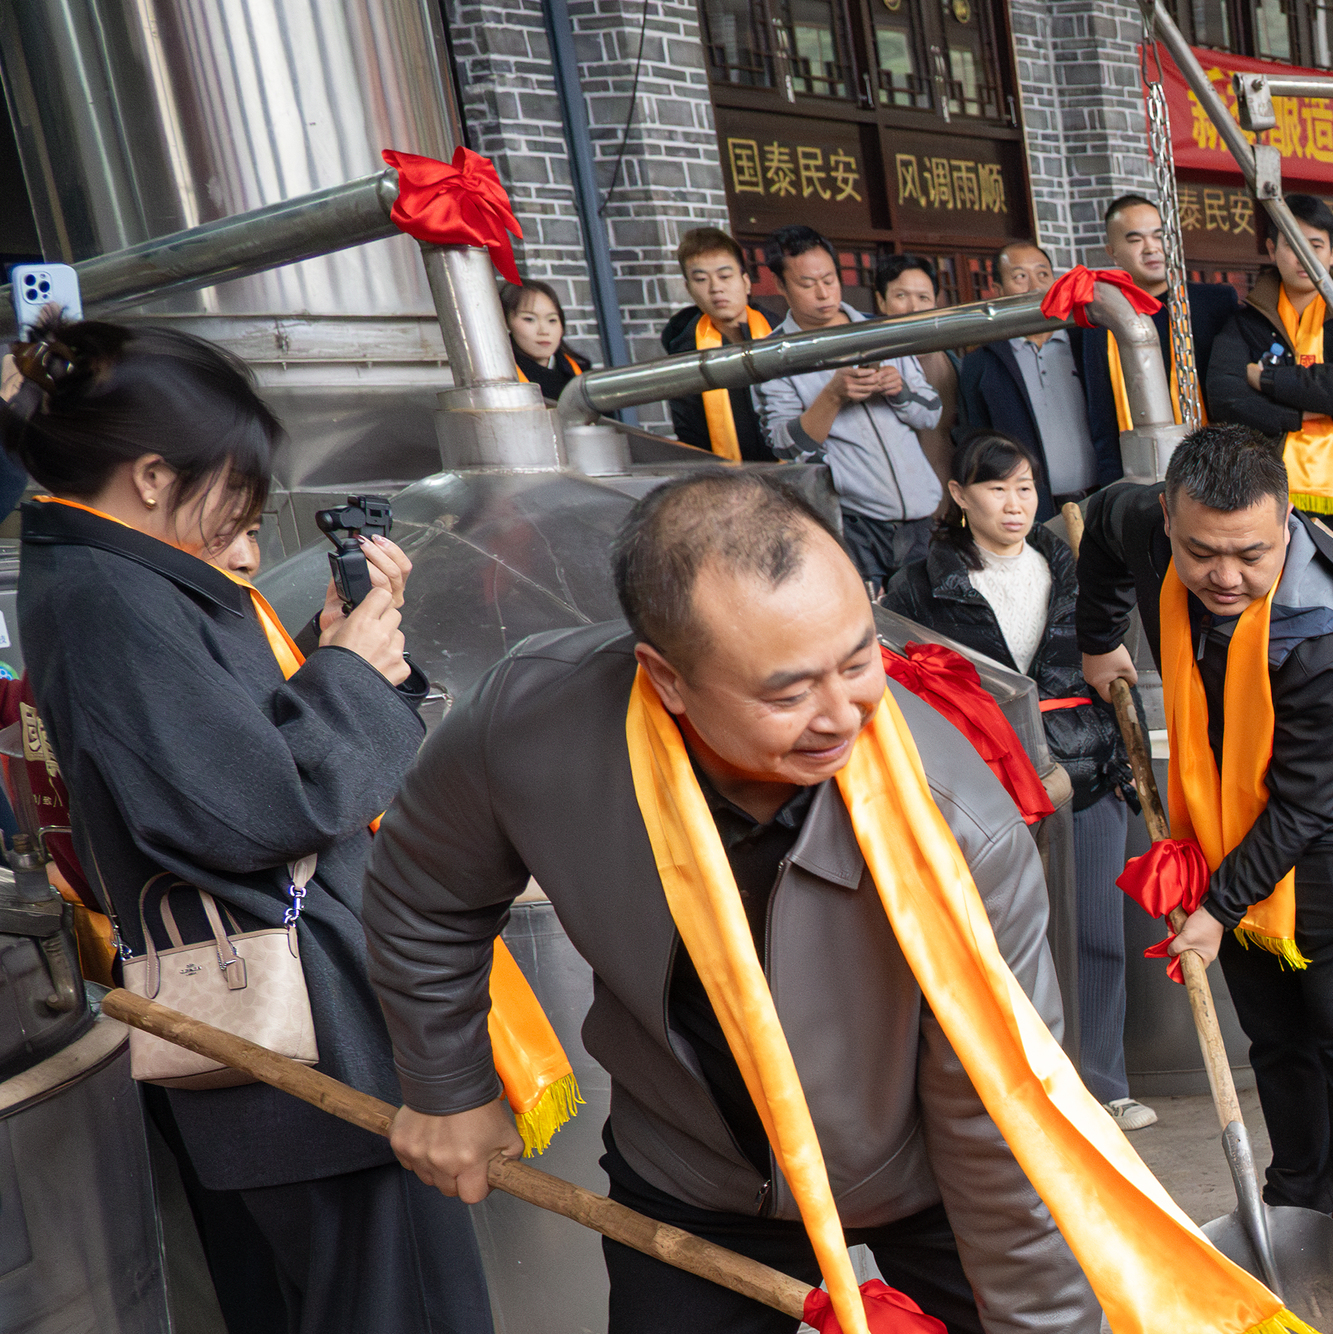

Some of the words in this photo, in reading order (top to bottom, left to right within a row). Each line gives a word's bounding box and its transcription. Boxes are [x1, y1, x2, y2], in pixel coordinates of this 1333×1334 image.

[727, 137, 862, 202] 国泰民安
[896, 153, 1008, 214] 风调雨顺
